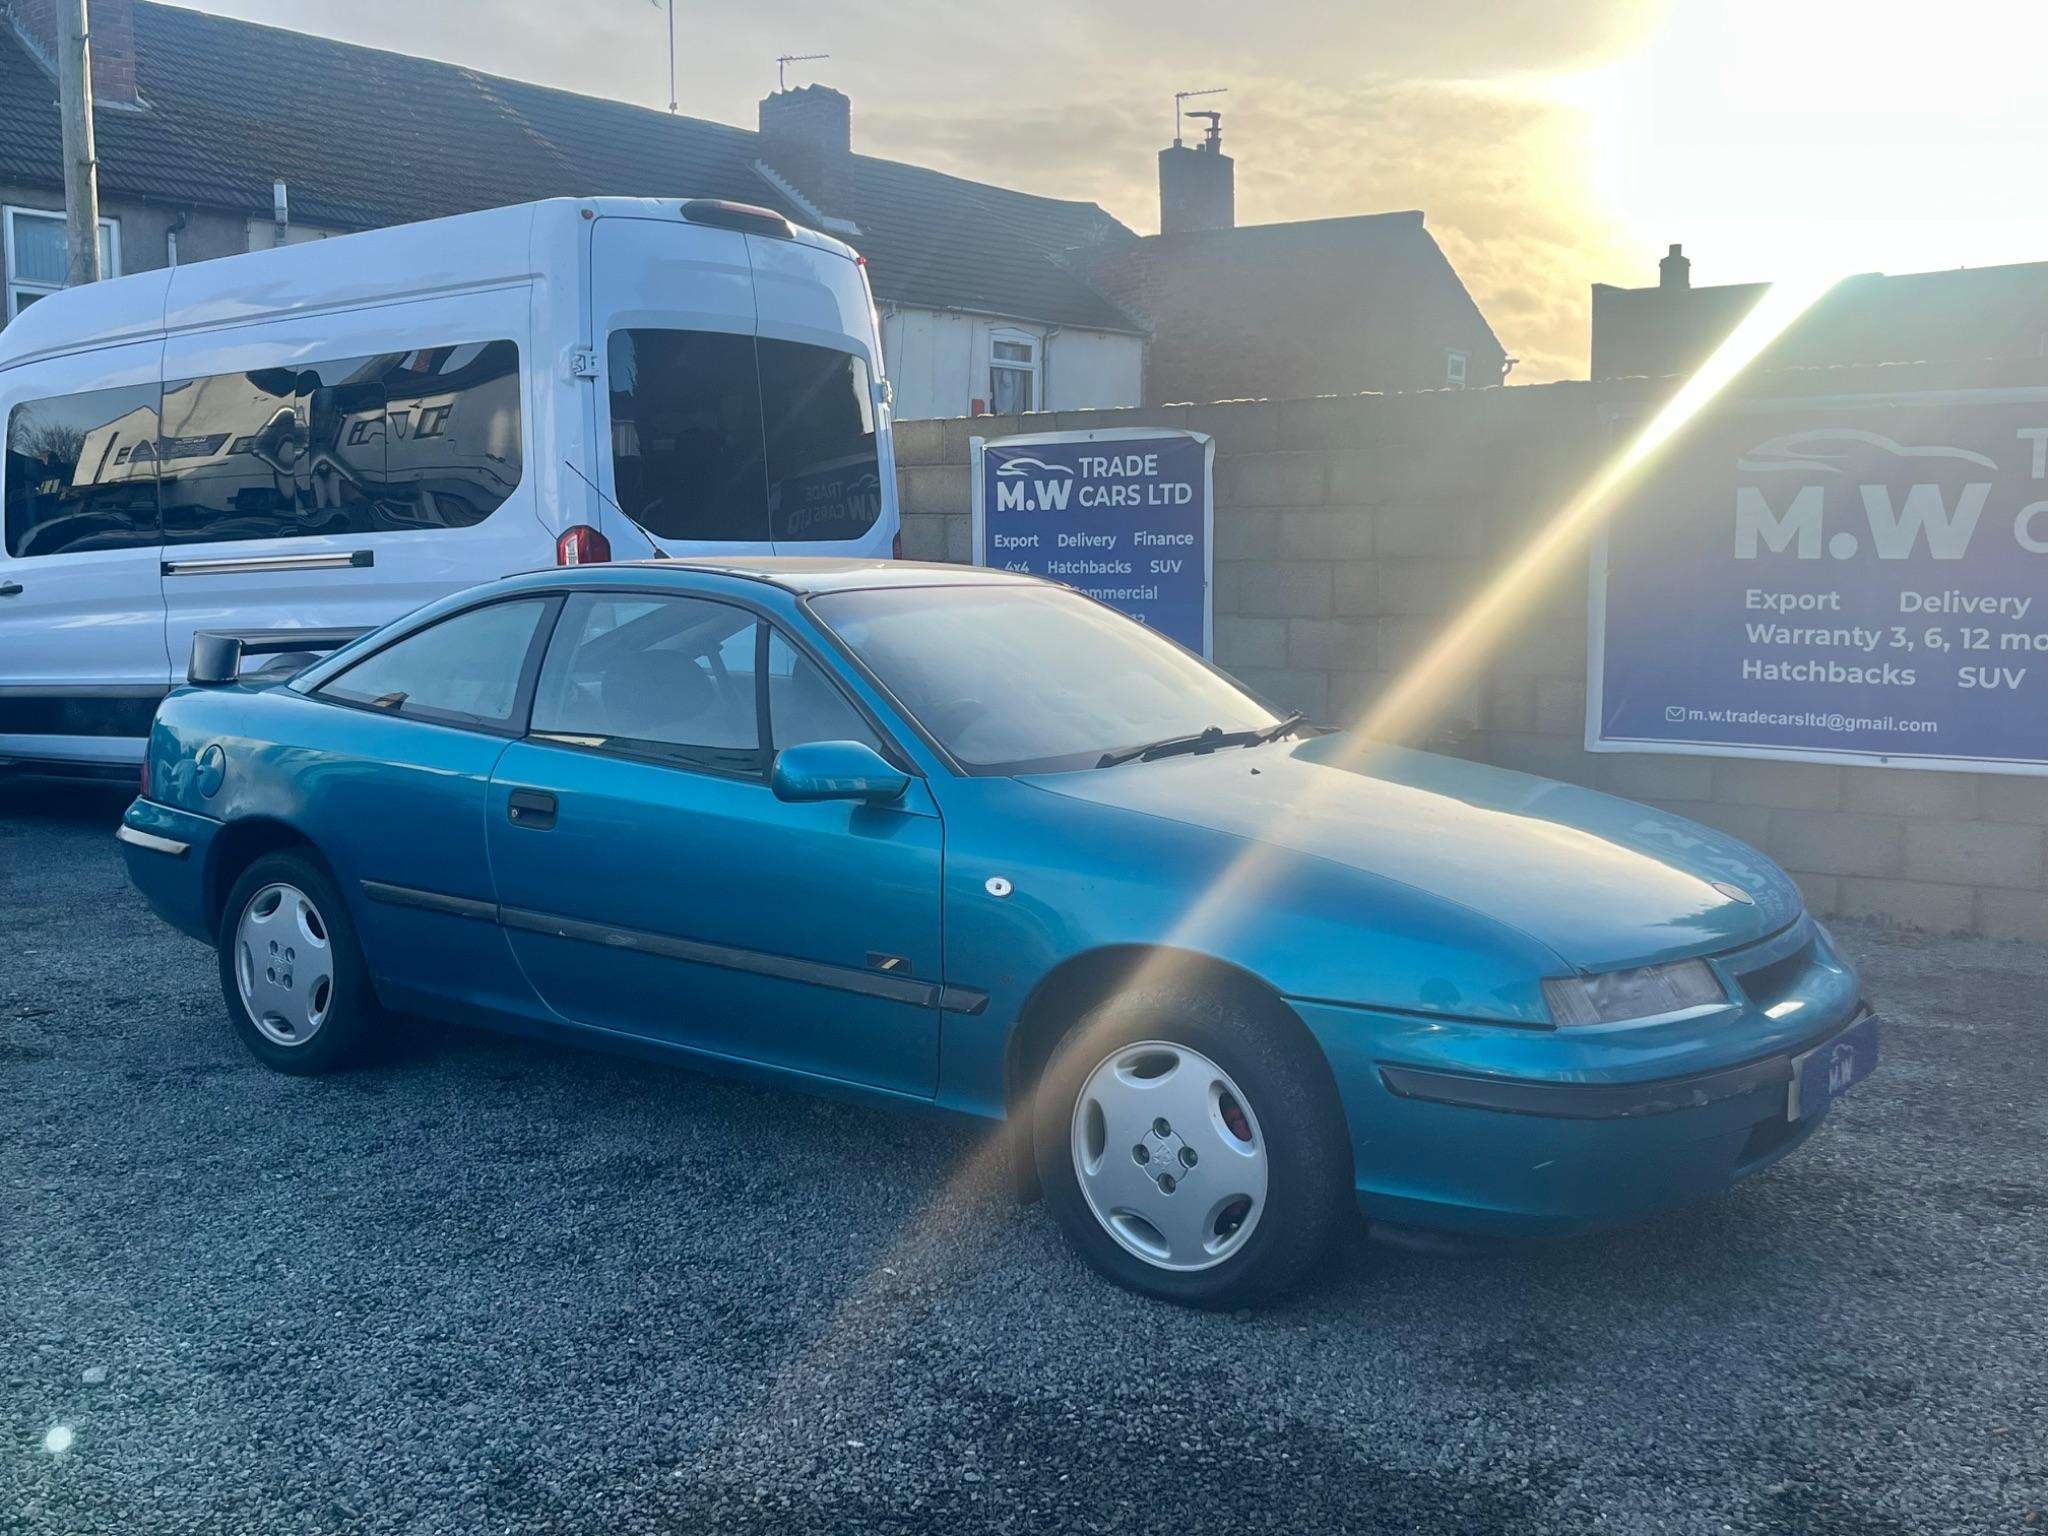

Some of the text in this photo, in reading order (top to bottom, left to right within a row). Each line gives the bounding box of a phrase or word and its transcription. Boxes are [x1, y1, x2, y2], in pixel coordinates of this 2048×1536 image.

[1079, 454, 1158, 478] TRADE
[997, 478, 1074, 512] M.W
[1078, 483, 1193, 507] CARS LTD
[1734, 482, 1993, 560] M.W
[994, 531, 1194, 550] Export Delivery Finance
[1005, 559, 1184, 574] 4x4 Hatchbacks SUV
[1745, 589, 2032, 619] Export Delivery
[1745, 623, 1882, 652] Warranty
[1890, 627, 1914, 653] 3,
[1923, 627, 1951, 653] 6,
[1960, 628, 1991, 650] 12
[1742, 659, 2026, 690] Hatchbacks SUV
[1688, 706, 1938, 733] m.w.tradecarsltd@gmail.com
